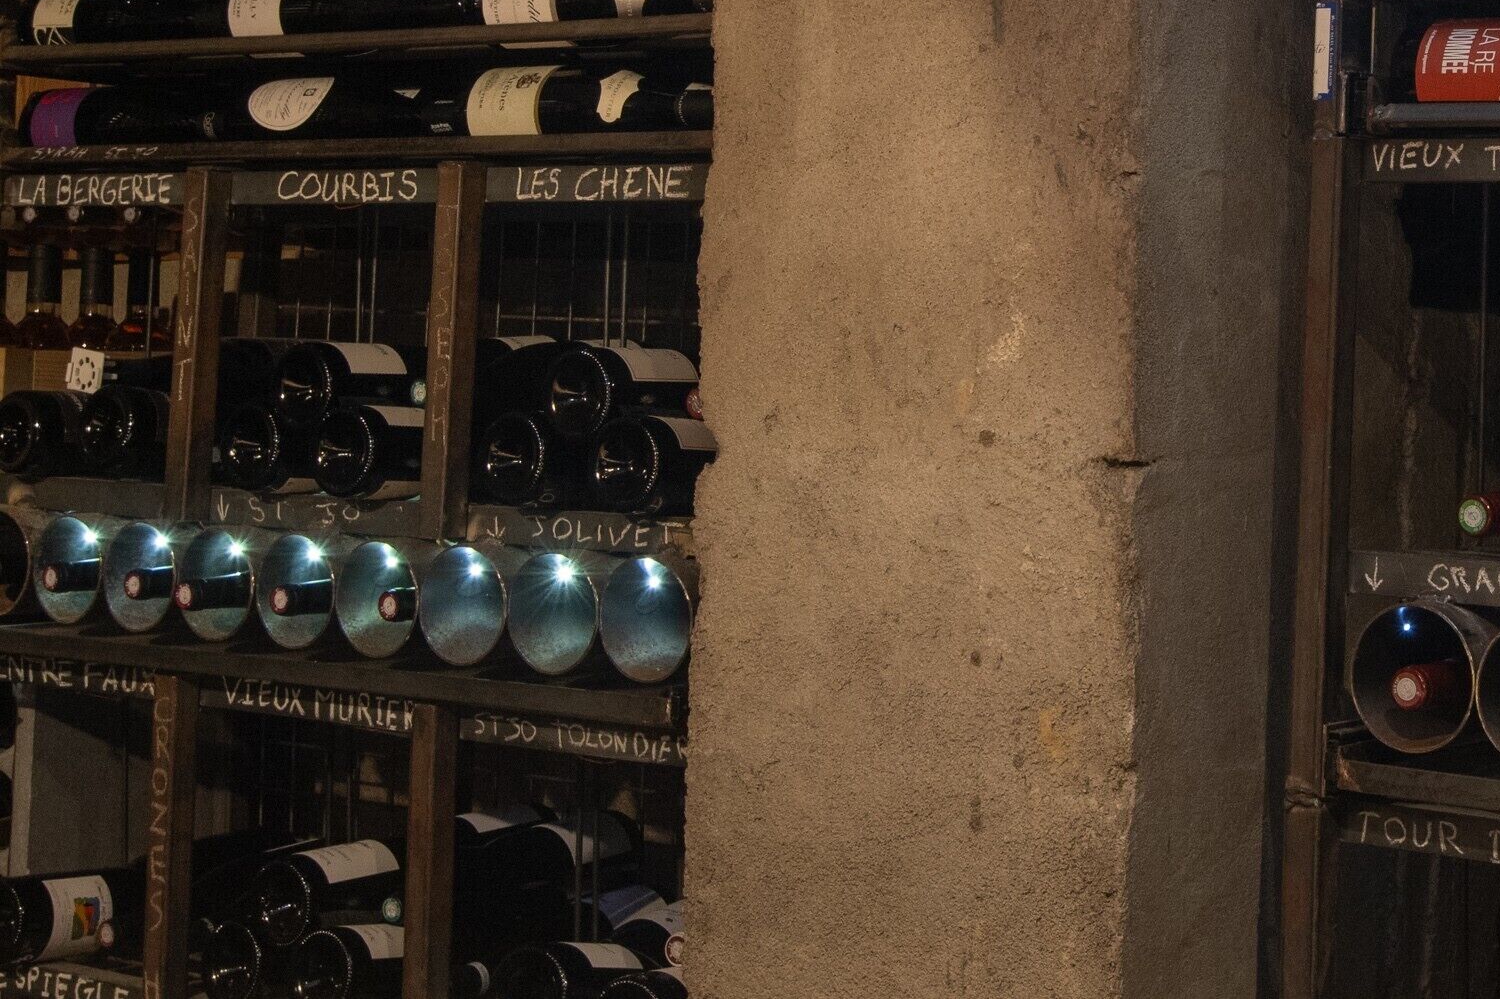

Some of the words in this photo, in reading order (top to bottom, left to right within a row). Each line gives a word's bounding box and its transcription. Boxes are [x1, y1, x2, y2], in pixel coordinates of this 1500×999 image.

[1441, 28, 1480, 75] NOMMÉE
[1473, 50, 1497, 74] RE
[1372, 140, 1466, 172] VIEUX
[18, 175, 47, 206] LA
[56, 173, 175, 206] BERGERIE
[277, 170, 418, 201] COURBIS
[515, 166, 560, 200] LES
[574, 163, 695, 200] CHENE
[175, 199, 198, 401] SAINT
[531, 514, 692, 548] JOLIVET
[82, 662, 156, 696] FAUX
[222, 674, 306, 715] VIEUX
[313, 689, 414, 732] MURIER
[1357, 810, 1465, 856] TOUR
